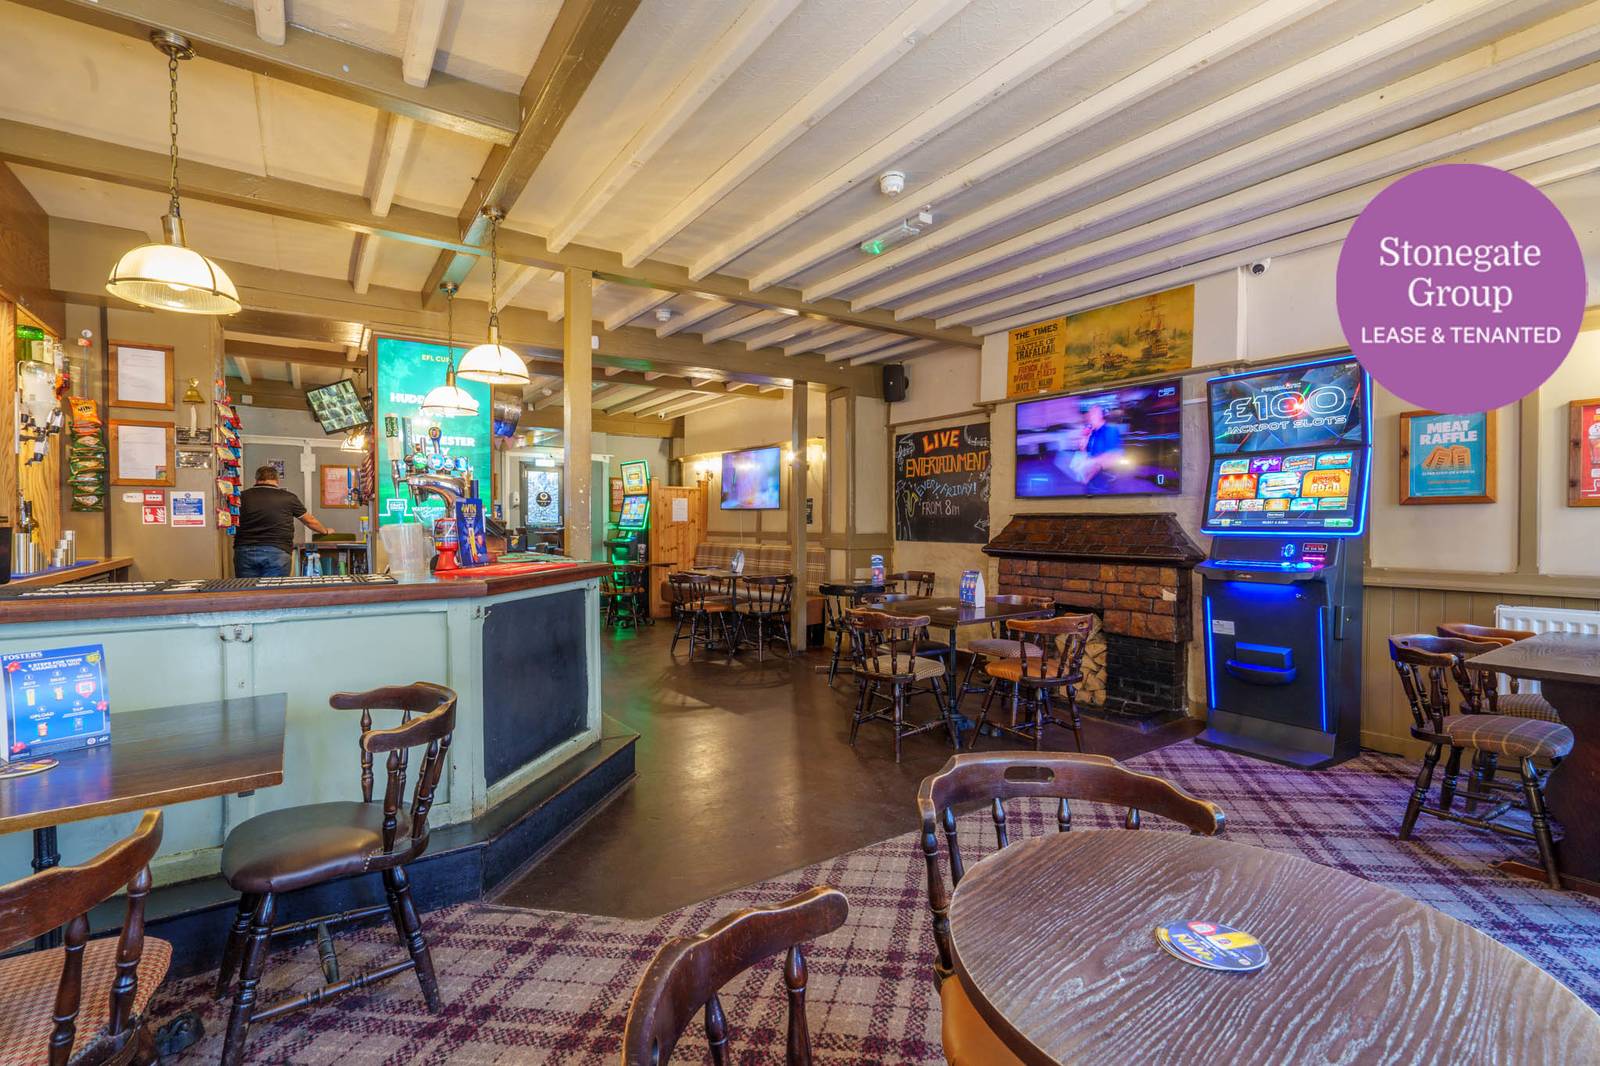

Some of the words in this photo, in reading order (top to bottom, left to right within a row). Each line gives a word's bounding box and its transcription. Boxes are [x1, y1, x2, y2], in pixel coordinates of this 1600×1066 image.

[1015, 330, 1030, 340] THE
[1033, 323, 1058, 336] TIMES
[1016, 344, 1056, 360] TRAFALGAR
[1223, 385, 1346, 425] £100
[1227, 420, 1290, 435] JACKPOT
[1293, 414, 1347, 429] SLOTS
[1427, 419, 1471, 434] MEAT
[922, 429, 961, 454] LIVE
[1419, 430, 1478, 446] RAFFLE
[905, 450, 989, 478] ENTERTAINMENT
[916, 480, 941, 497] EVERY
[922, 501, 943, 515] FROM
